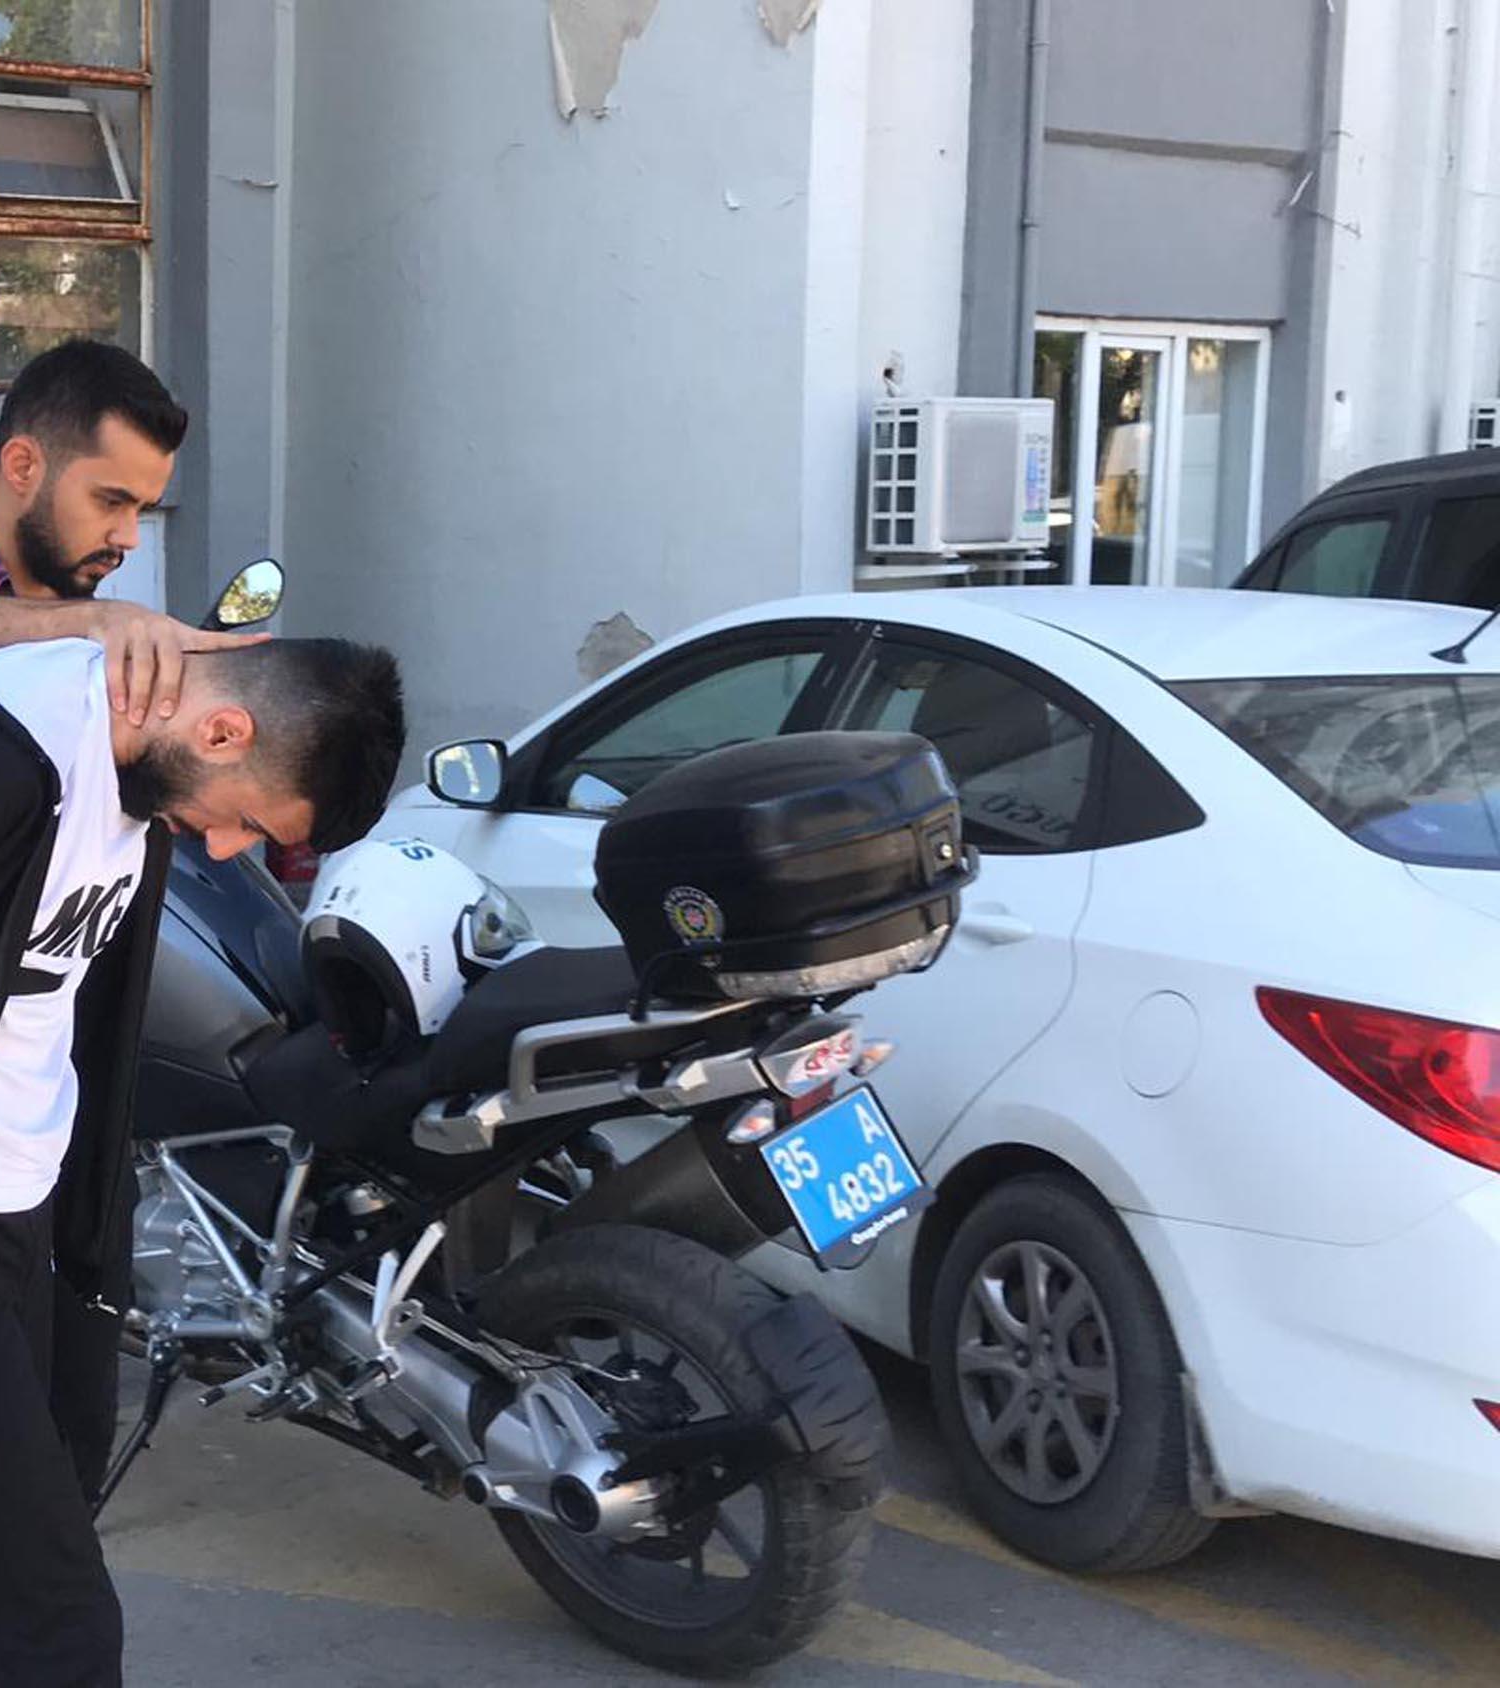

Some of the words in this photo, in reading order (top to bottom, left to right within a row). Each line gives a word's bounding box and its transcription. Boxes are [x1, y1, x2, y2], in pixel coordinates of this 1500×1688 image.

[772, 1137, 820, 1190] 35
[854, 1103, 885, 1144] A
[827, 1151, 905, 1221] 4832
